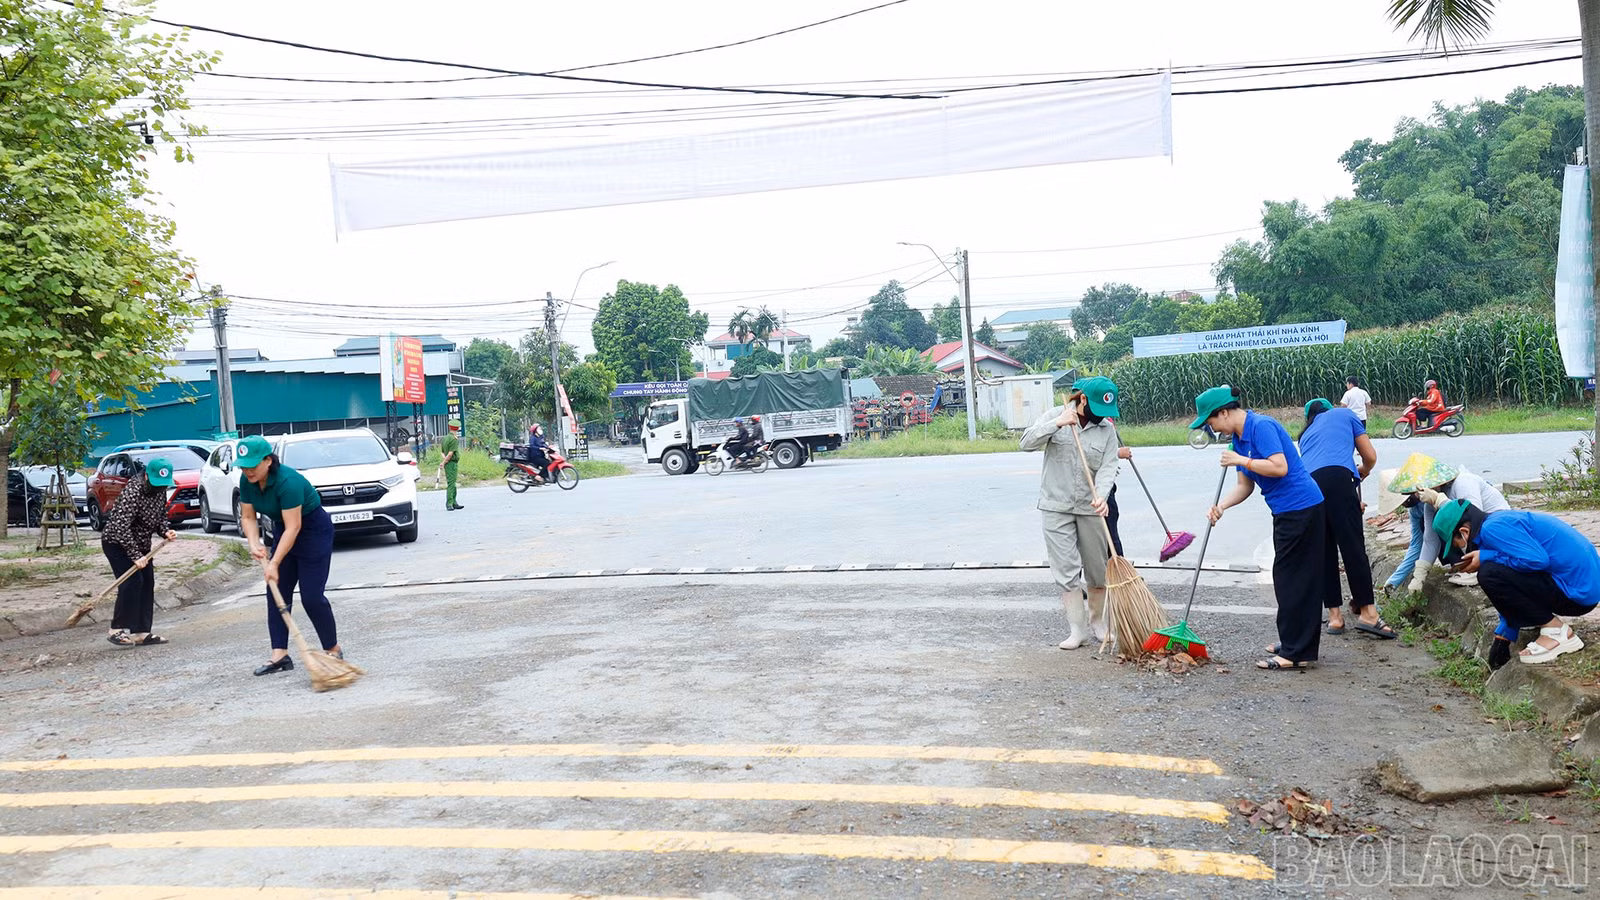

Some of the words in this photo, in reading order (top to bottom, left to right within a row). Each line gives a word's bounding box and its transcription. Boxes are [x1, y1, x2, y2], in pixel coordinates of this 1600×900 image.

[1198, 341, 1207, 350] LÀ
[1209, 339, 1233, 349] TRÁCH
[1235, 338, 1260, 347] NHIỆM
[1261, 336, 1277, 345] CỦA
[1279, 335, 1300, 344] TOÀN
[1302, 334, 1313, 342] XÃ
[1315, 332, 1329, 342] HỘI
[1205, 332, 1224, 341] GIẢM
[1226, 330, 1245, 339] PHÁT
[1247, 328, 1265, 337] THẢI
[1267, 328, 1280, 336] KHÍ
[1281, 326, 1298, 334] NHÀ
[1300, 325, 1320, 333] KÍNH
